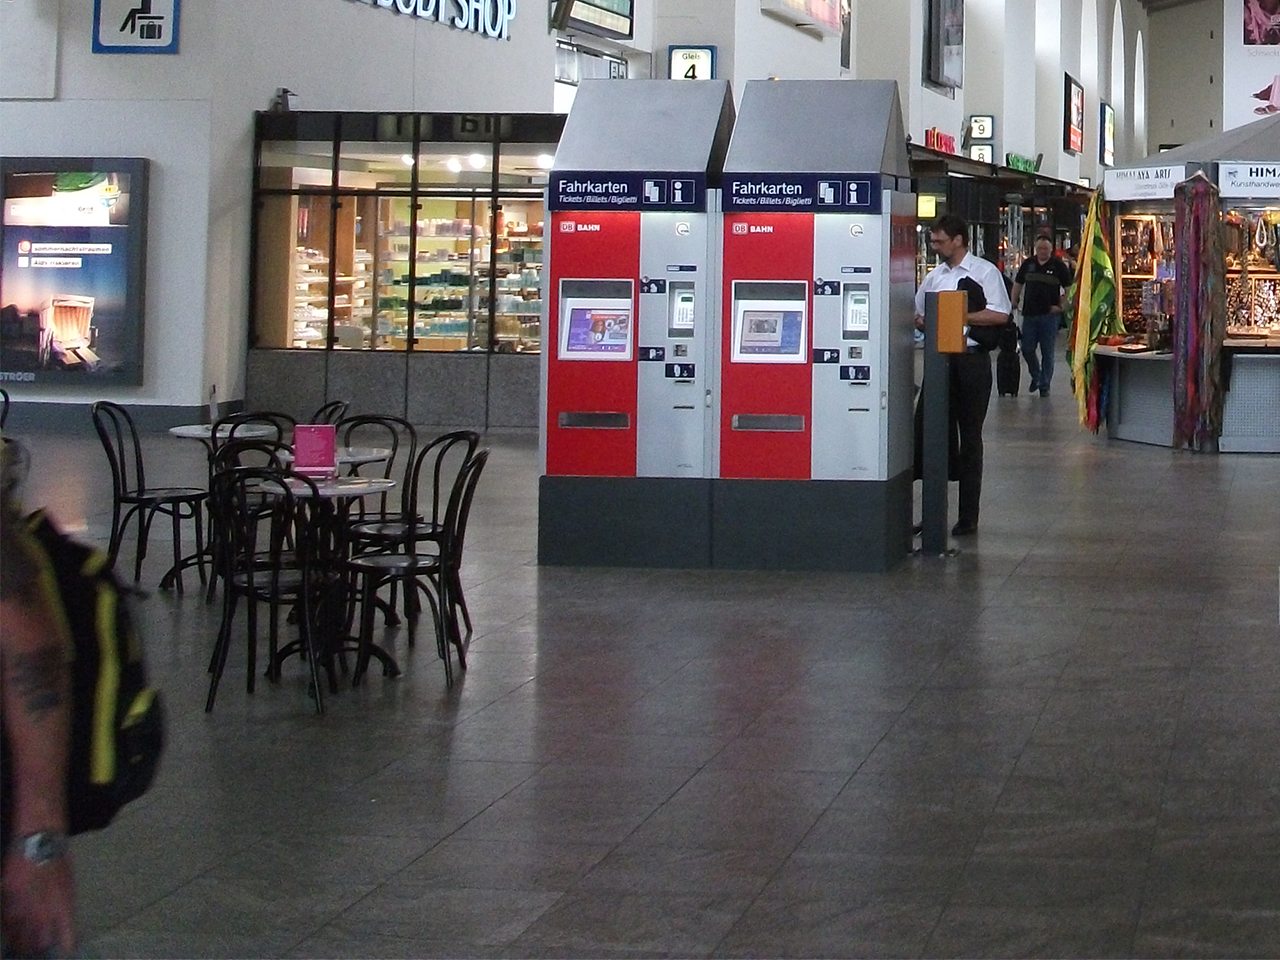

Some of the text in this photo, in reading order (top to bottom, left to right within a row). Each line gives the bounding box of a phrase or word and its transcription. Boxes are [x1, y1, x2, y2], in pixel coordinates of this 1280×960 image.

[1247, 49, 1280, 57] Schmeckt
[684, 64, 698, 79] 4
[978, 124, 985, 135] 9
[1154, 169, 1171, 179] ARTS
[559, 180, 628, 193] Fahrkarten
[732, 182, 802, 195] Fahrkarten
[562, 223, 573, 231] DB
